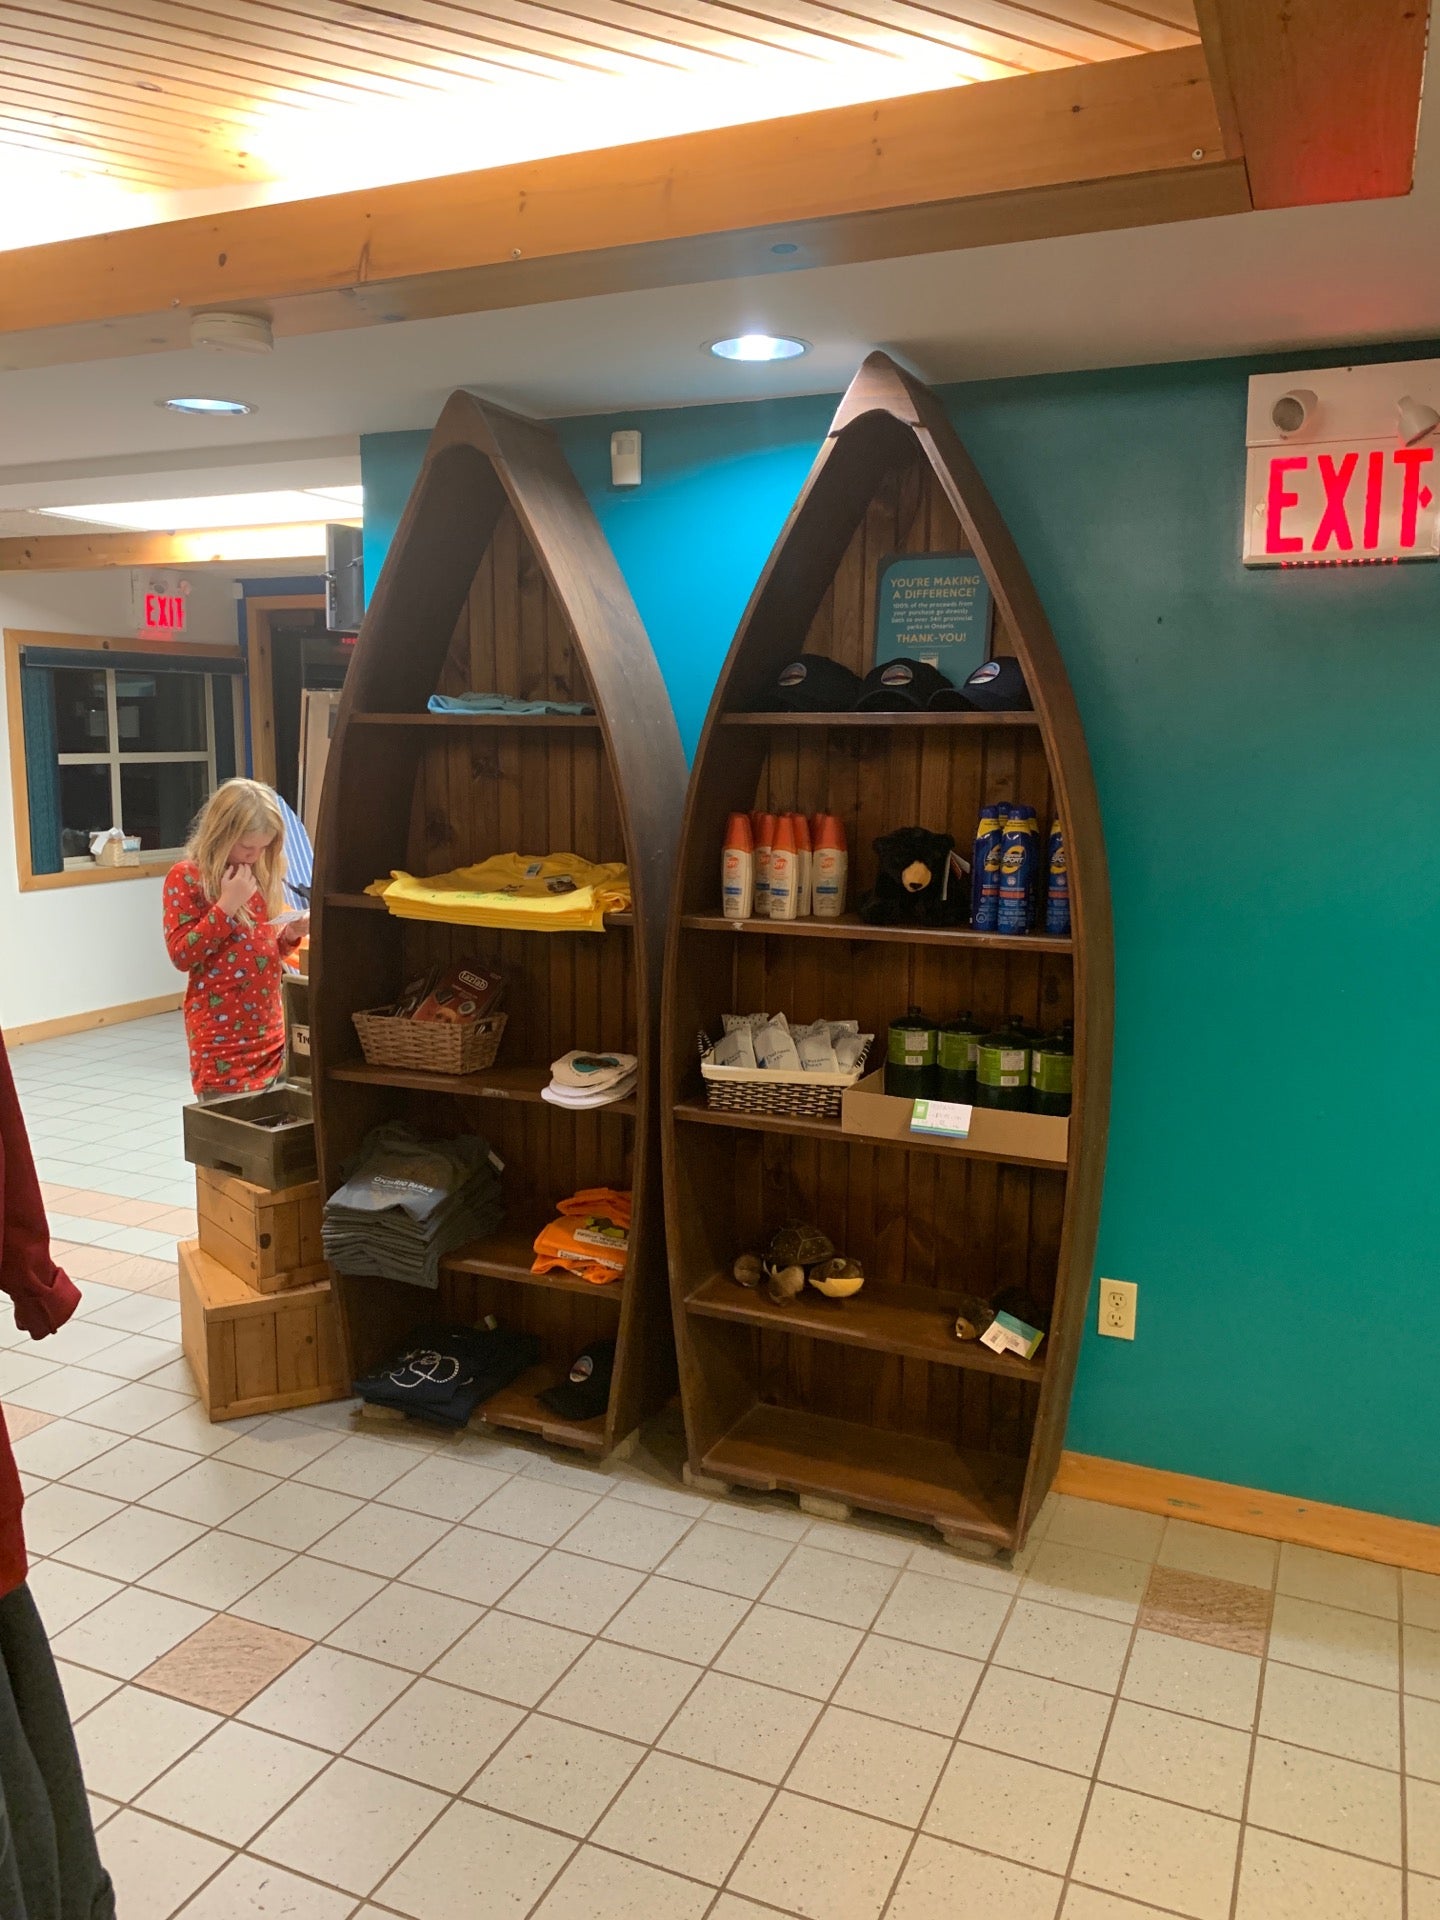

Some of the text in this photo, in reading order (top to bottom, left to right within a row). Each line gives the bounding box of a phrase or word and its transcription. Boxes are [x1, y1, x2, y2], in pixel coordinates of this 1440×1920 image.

[1265, 448, 1434, 554] EXIT
[890, 575, 980, 588] YOU'RE MAKING
[893, 587, 976, 599] A DIFFERENCE!
[145, 593, 185, 629] EXIT
[929, 601, 957, 609] proceeds
[908, 609, 934, 617] purchase
[945, 607, 968, 615] directly
[896, 632, 967, 643] THANK-YOU!
